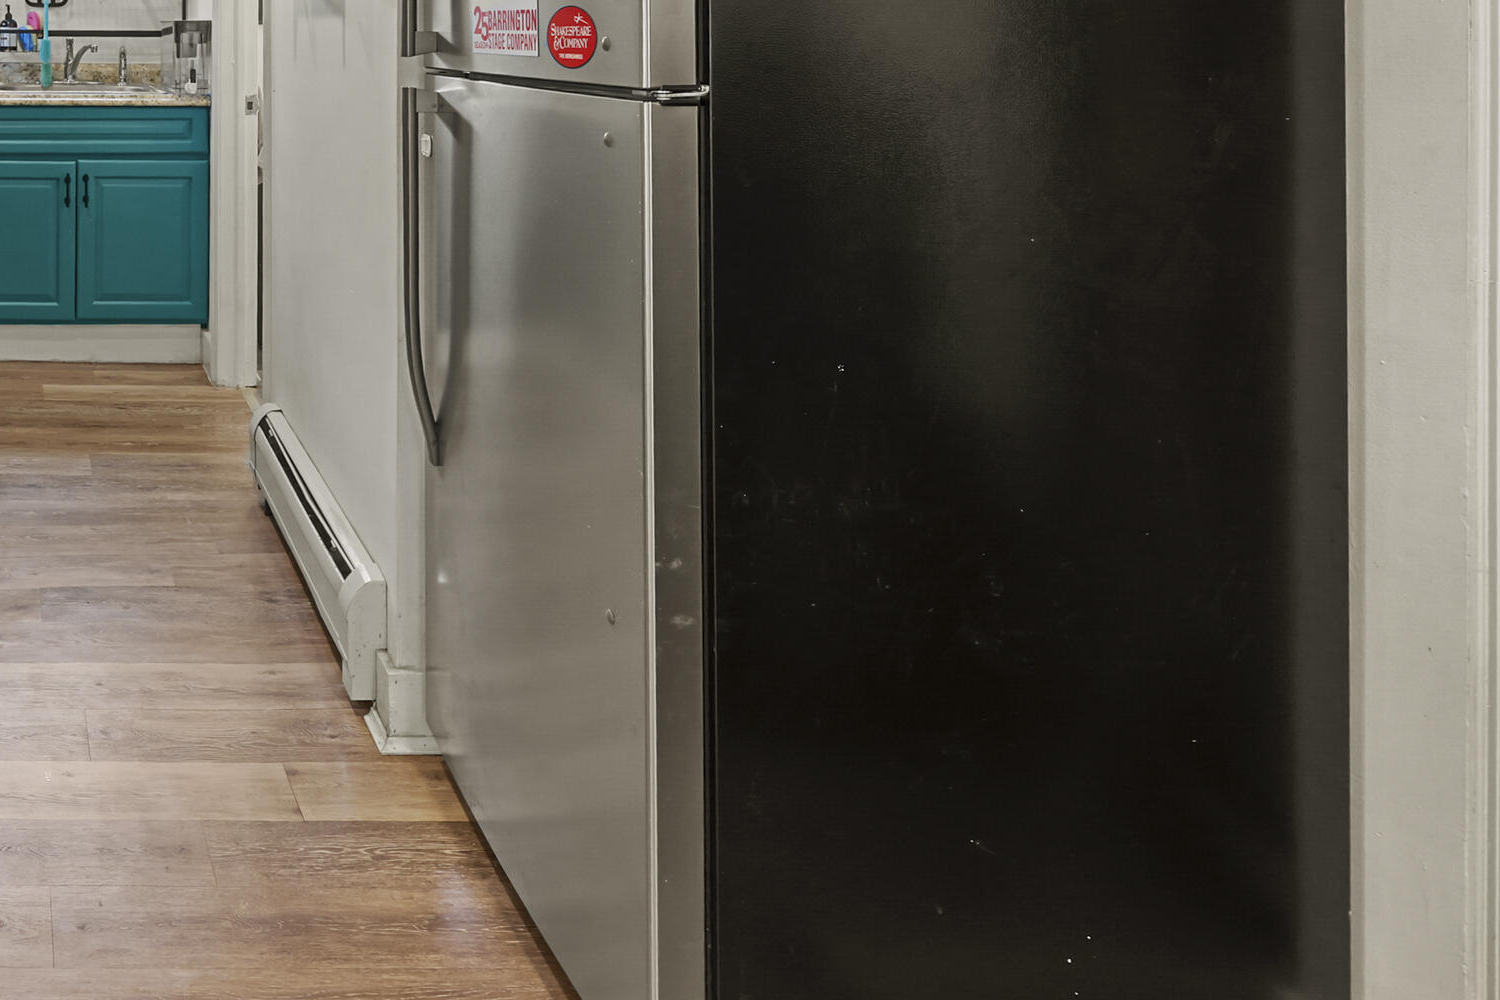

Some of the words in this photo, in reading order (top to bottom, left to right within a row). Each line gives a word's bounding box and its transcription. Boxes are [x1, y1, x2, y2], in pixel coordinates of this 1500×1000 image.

[474, 6, 489, 41] 25
[488, 9, 537, 31] BARRINGTON
[551, 23, 592, 36] SHAKESPEARE
[488, 33, 506, 50] STAGE
[507, 33, 537, 51] COMPANY
